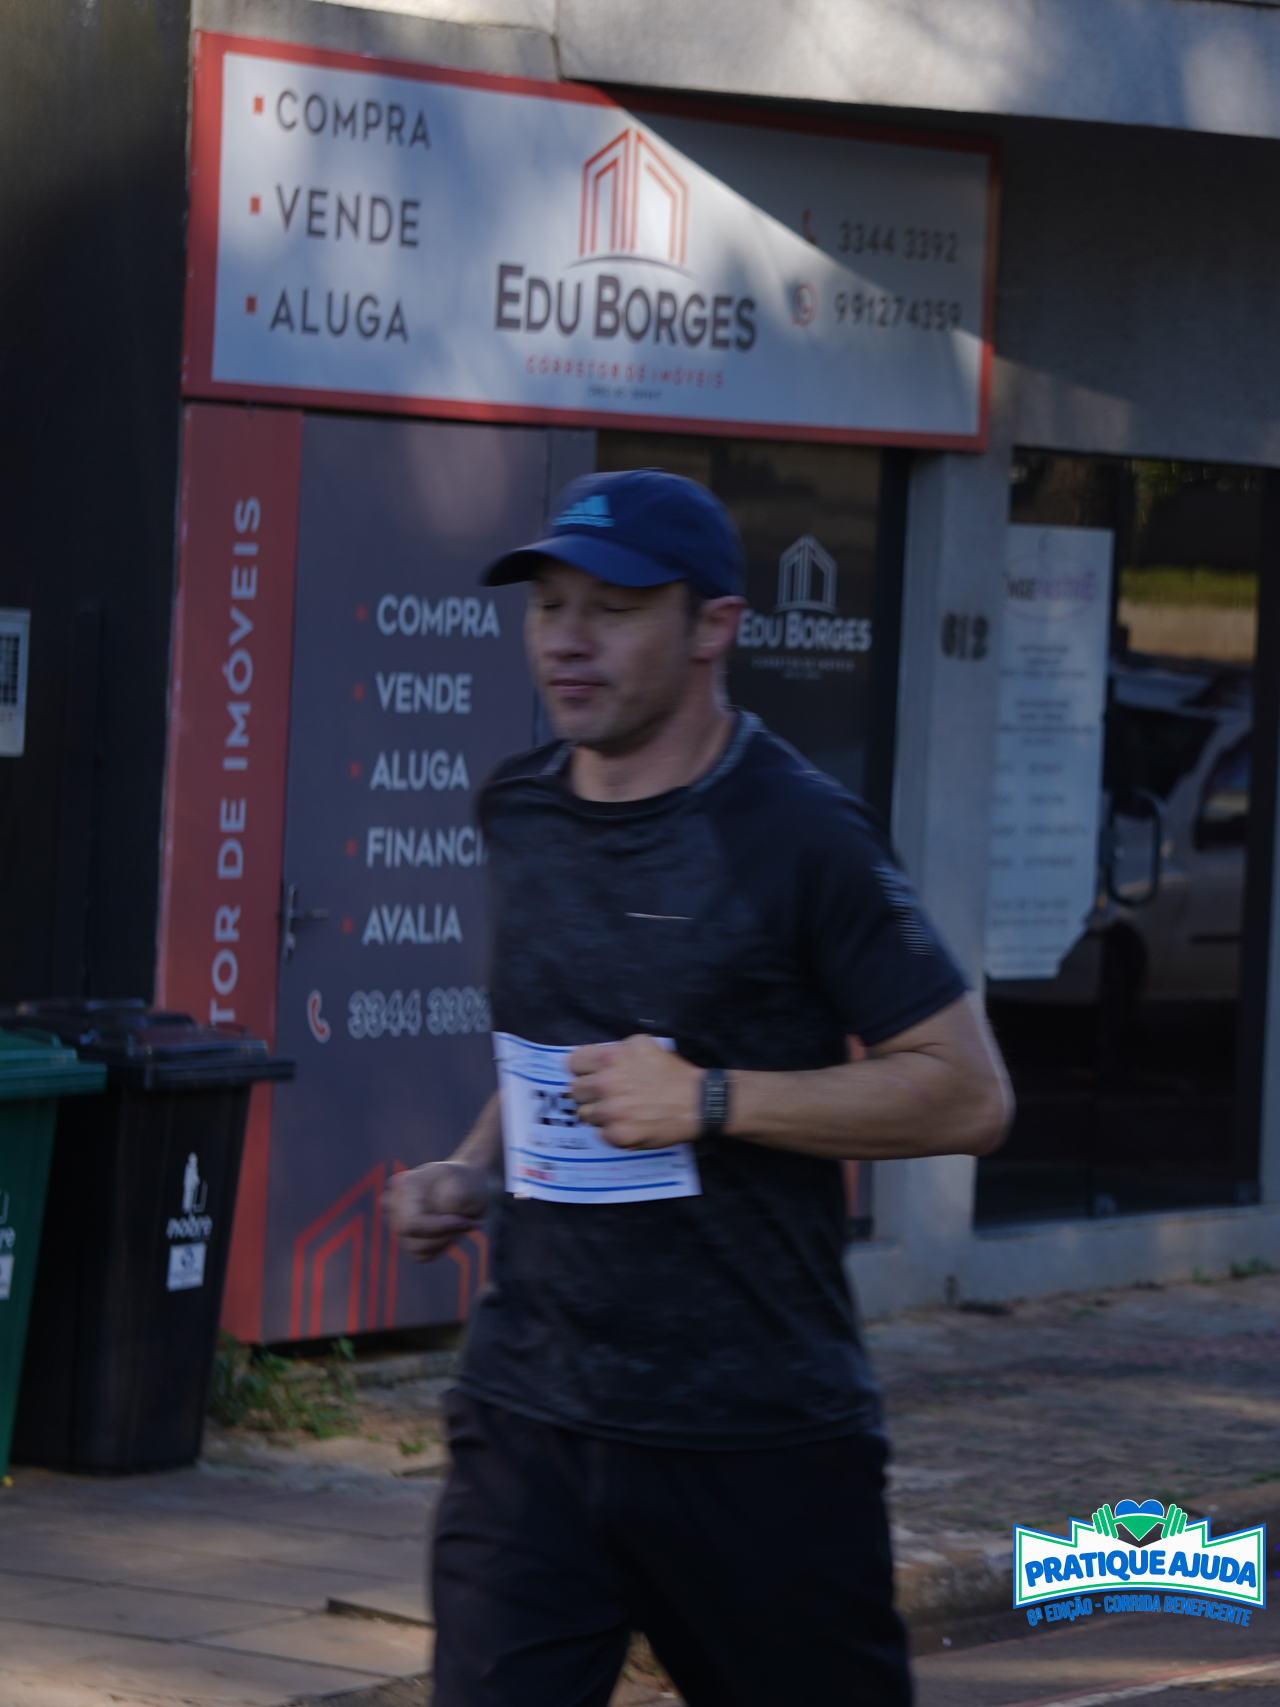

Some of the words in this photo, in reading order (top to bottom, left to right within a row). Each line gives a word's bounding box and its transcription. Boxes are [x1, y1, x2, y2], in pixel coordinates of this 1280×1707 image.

[276, 90, 431, 150] COMPRA
[276, 184, 420, 248] VENDE
[838, 221, 897, 257] 3344
[903, 227, 960, 264] 3392
[270, 289, 409, 343] ALUGA
[495, 264, 582, 335] EDU
[593, 274, 758, 352] BORGES
[222, 497, 261, 771] IMÓVEIS
[377, 595, 500, 637] COMPRA
[785, 611, 873, 653] BORGES
[376, 673, 472, 714] VENDE
[370, 750, 469, 791] ALUGA
[217, 798, 247, 879] DE
[366, 827, 489, 868] FINANCI
[362, 904, 462, 945] AVALIA
[347, 989, 422, 1039] 3344
